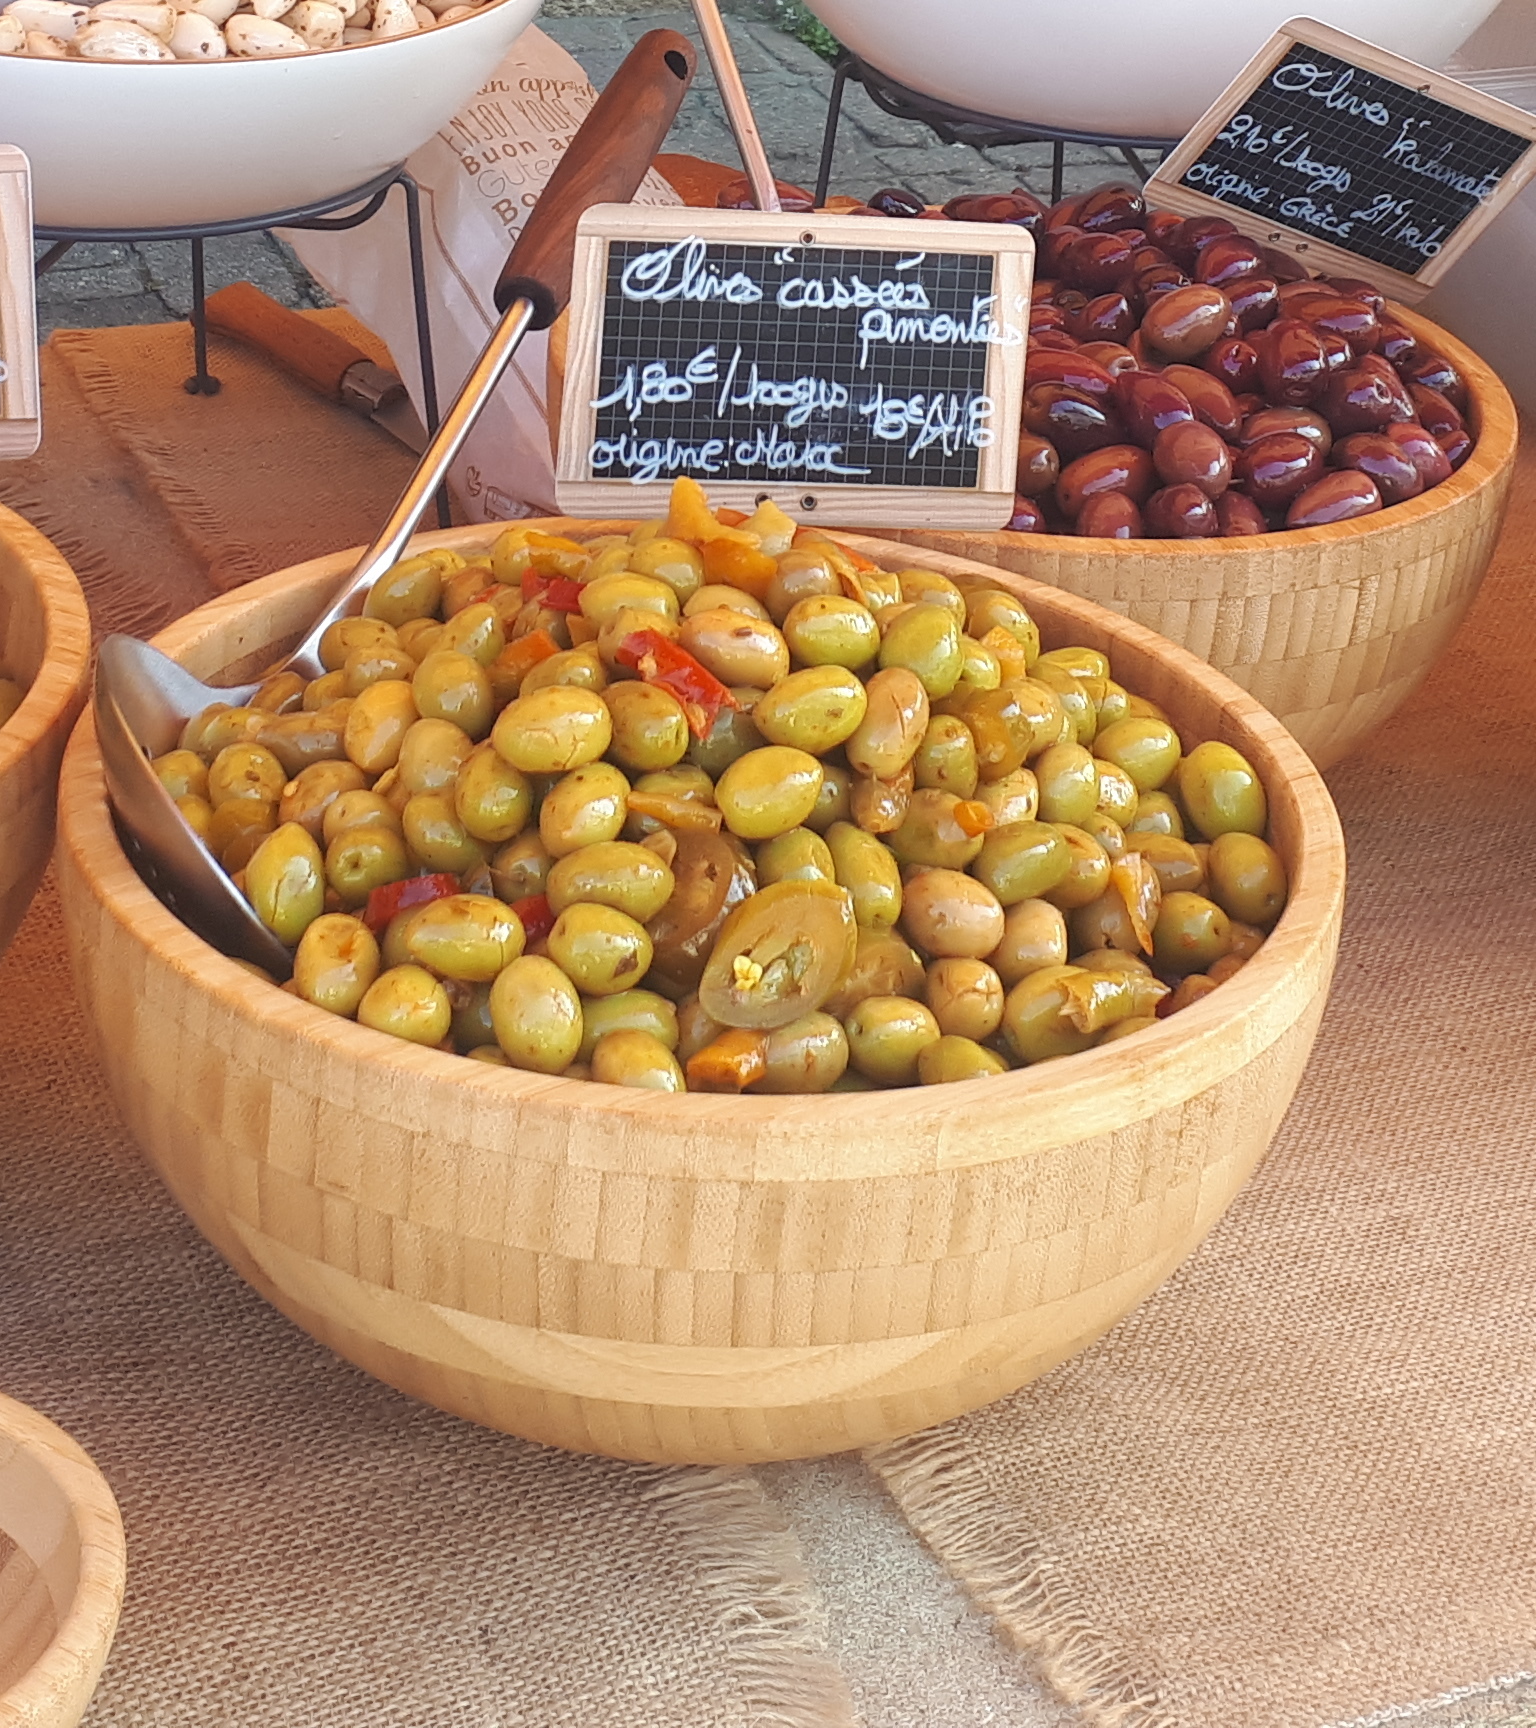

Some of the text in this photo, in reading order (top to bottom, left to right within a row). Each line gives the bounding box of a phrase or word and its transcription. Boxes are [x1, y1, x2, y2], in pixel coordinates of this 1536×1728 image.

[1272, 62, 1390, 127] Olives
[460, 138, 538, 176] Buon
[620, 233, 765, 304] Olives
